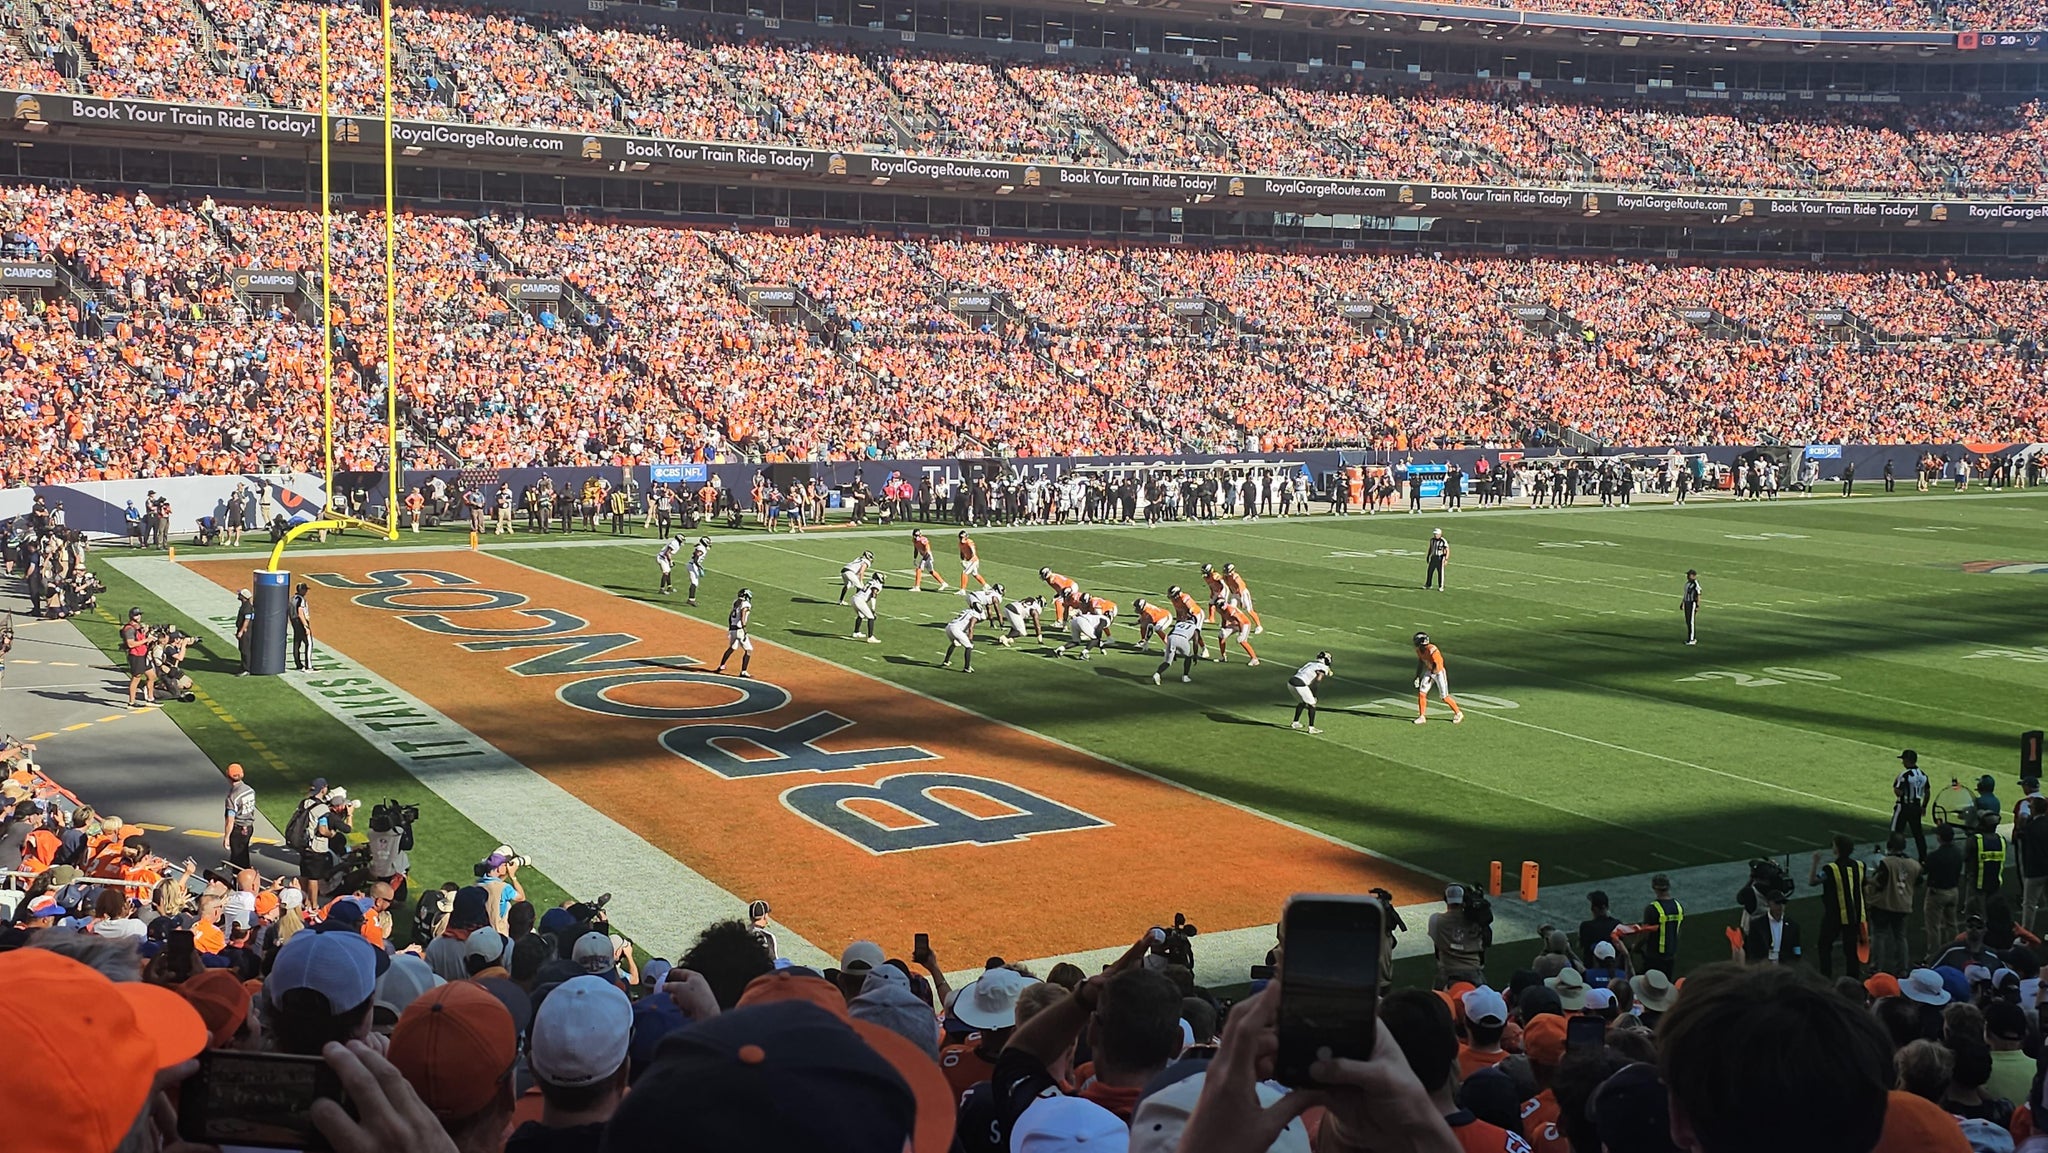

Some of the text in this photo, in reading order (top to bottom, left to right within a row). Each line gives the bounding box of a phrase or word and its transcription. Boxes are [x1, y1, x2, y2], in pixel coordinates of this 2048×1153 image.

[72, 100, 317, 137] Book Your Train Ride Today!
[392, 124, 563, 150] RoyalGorgeRoute.com
[626, 140, 815, 171] Book Your Train Ride Today!
[871, 157, 1010, 179] RoyalGorgeRoute.com
[1060, 169, 1217, 193] Book Your Train Ride Today!
[1265, 179, 1386, 198] RoyalGorgeRoute.com
[1430, 187, 1572, 207] Book Your Train Ride Today!
[1617, 195, 1728, 212] RoyalGorgeRoute.com
[1771, 201, 1919, 219] Book Your Train Ride Today!
[776, 217, 790, 227] 122
[977, 227, 990, 237] 123
[1170, 235, 1182, 245] 124
[4, 267, 53, 279] CAMPOS
[250, 274, 295, 286] CAMPOS
[521, 283, 561, 293] CAMPOS
[759, 291, 794, 301] CAMPOS
[958, 296, 991, 306] CAMPOS
[1175, 301, 1205, 311] CAMPOS
[1345, 304, 1374, 313] CAMPOS
[1518, 307, 1547, 316] CAMPOS
[1685, 310, 1712, 319] CAMPOS
[1815, 313, 1842, 321] CAMPOS
[662, 467, 703, 477] CBS NFL
[1694, 666, 1842, 687] 20
[305, 677, 439, 731] TAKES
[302, 568, 1115, 856] BRONCOS
[391, 739, 485, 761] IT
[2029, 737, 2037, 762] 1
